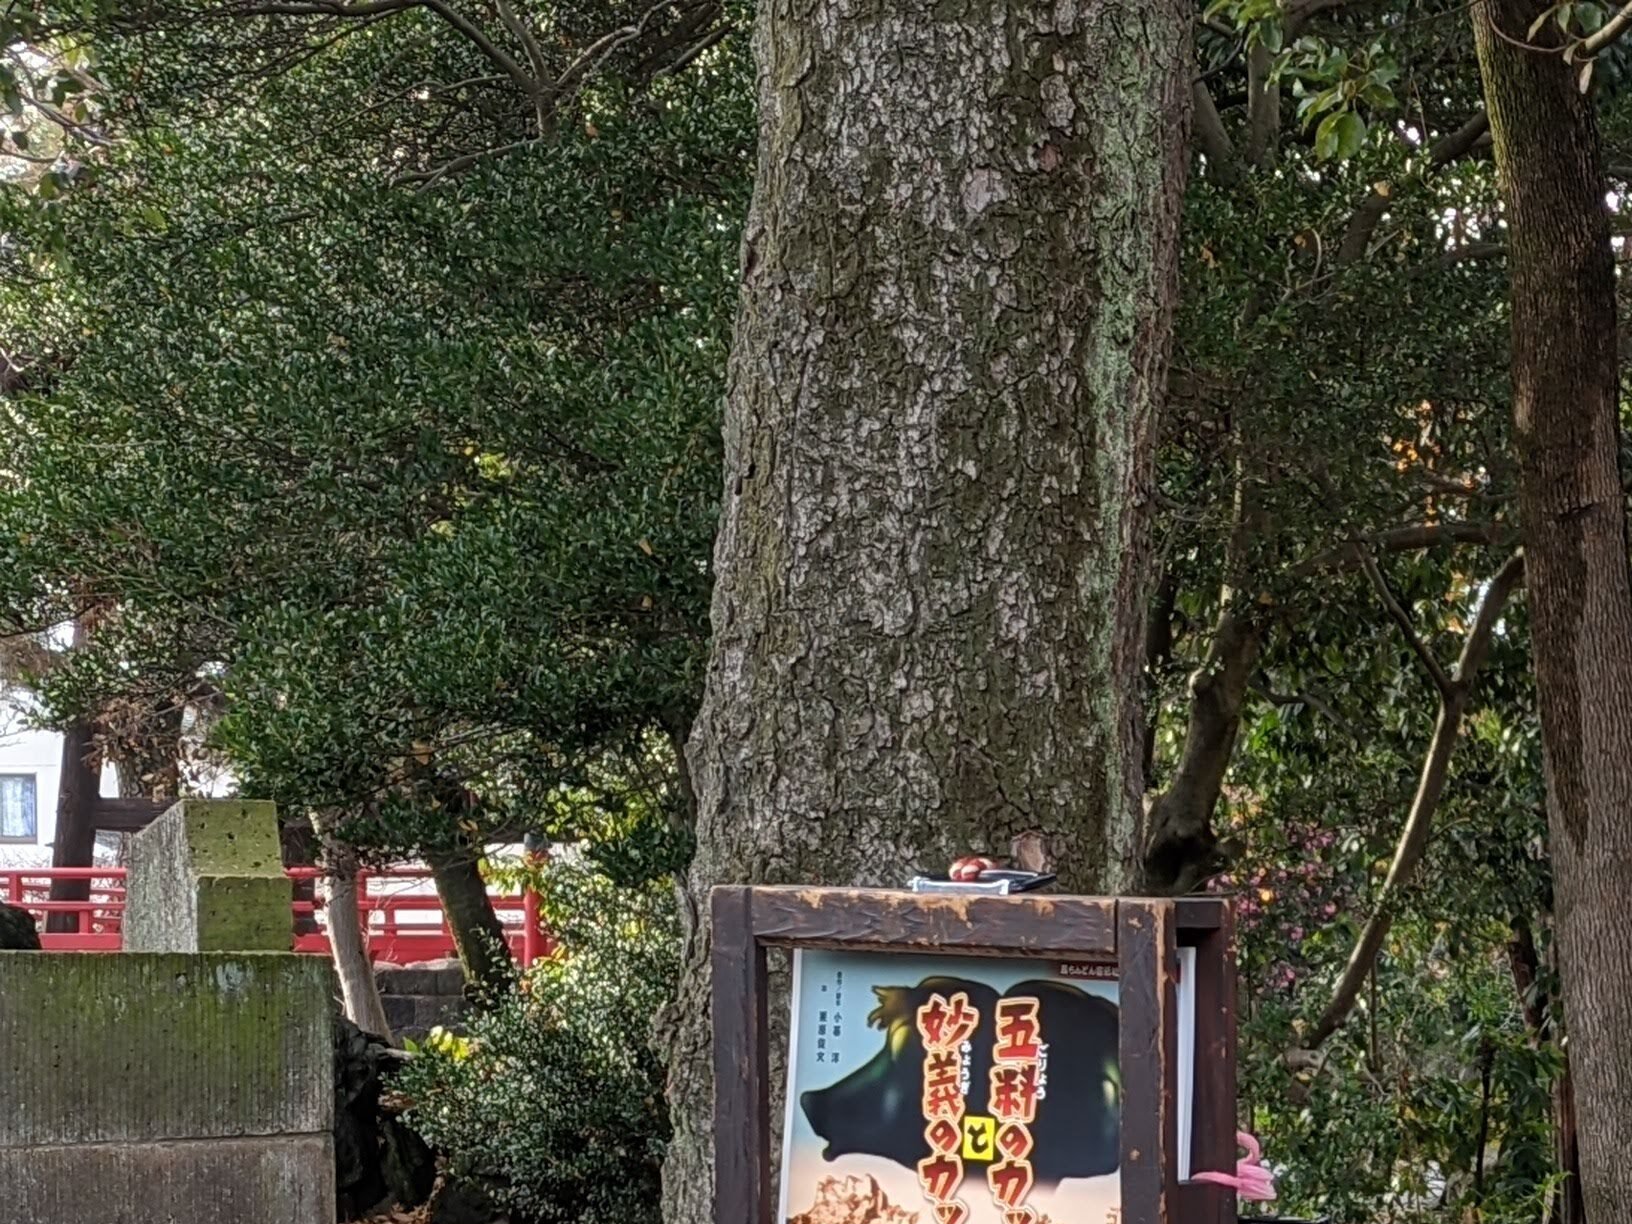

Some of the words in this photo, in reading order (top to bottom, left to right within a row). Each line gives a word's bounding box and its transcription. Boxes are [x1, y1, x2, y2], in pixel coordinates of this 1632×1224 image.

[959, 1040, 972, 1096] みょうぎ
[1037, 1043, 1050, 1101] ごりょう
[965, 1118, 992, 1156] と
